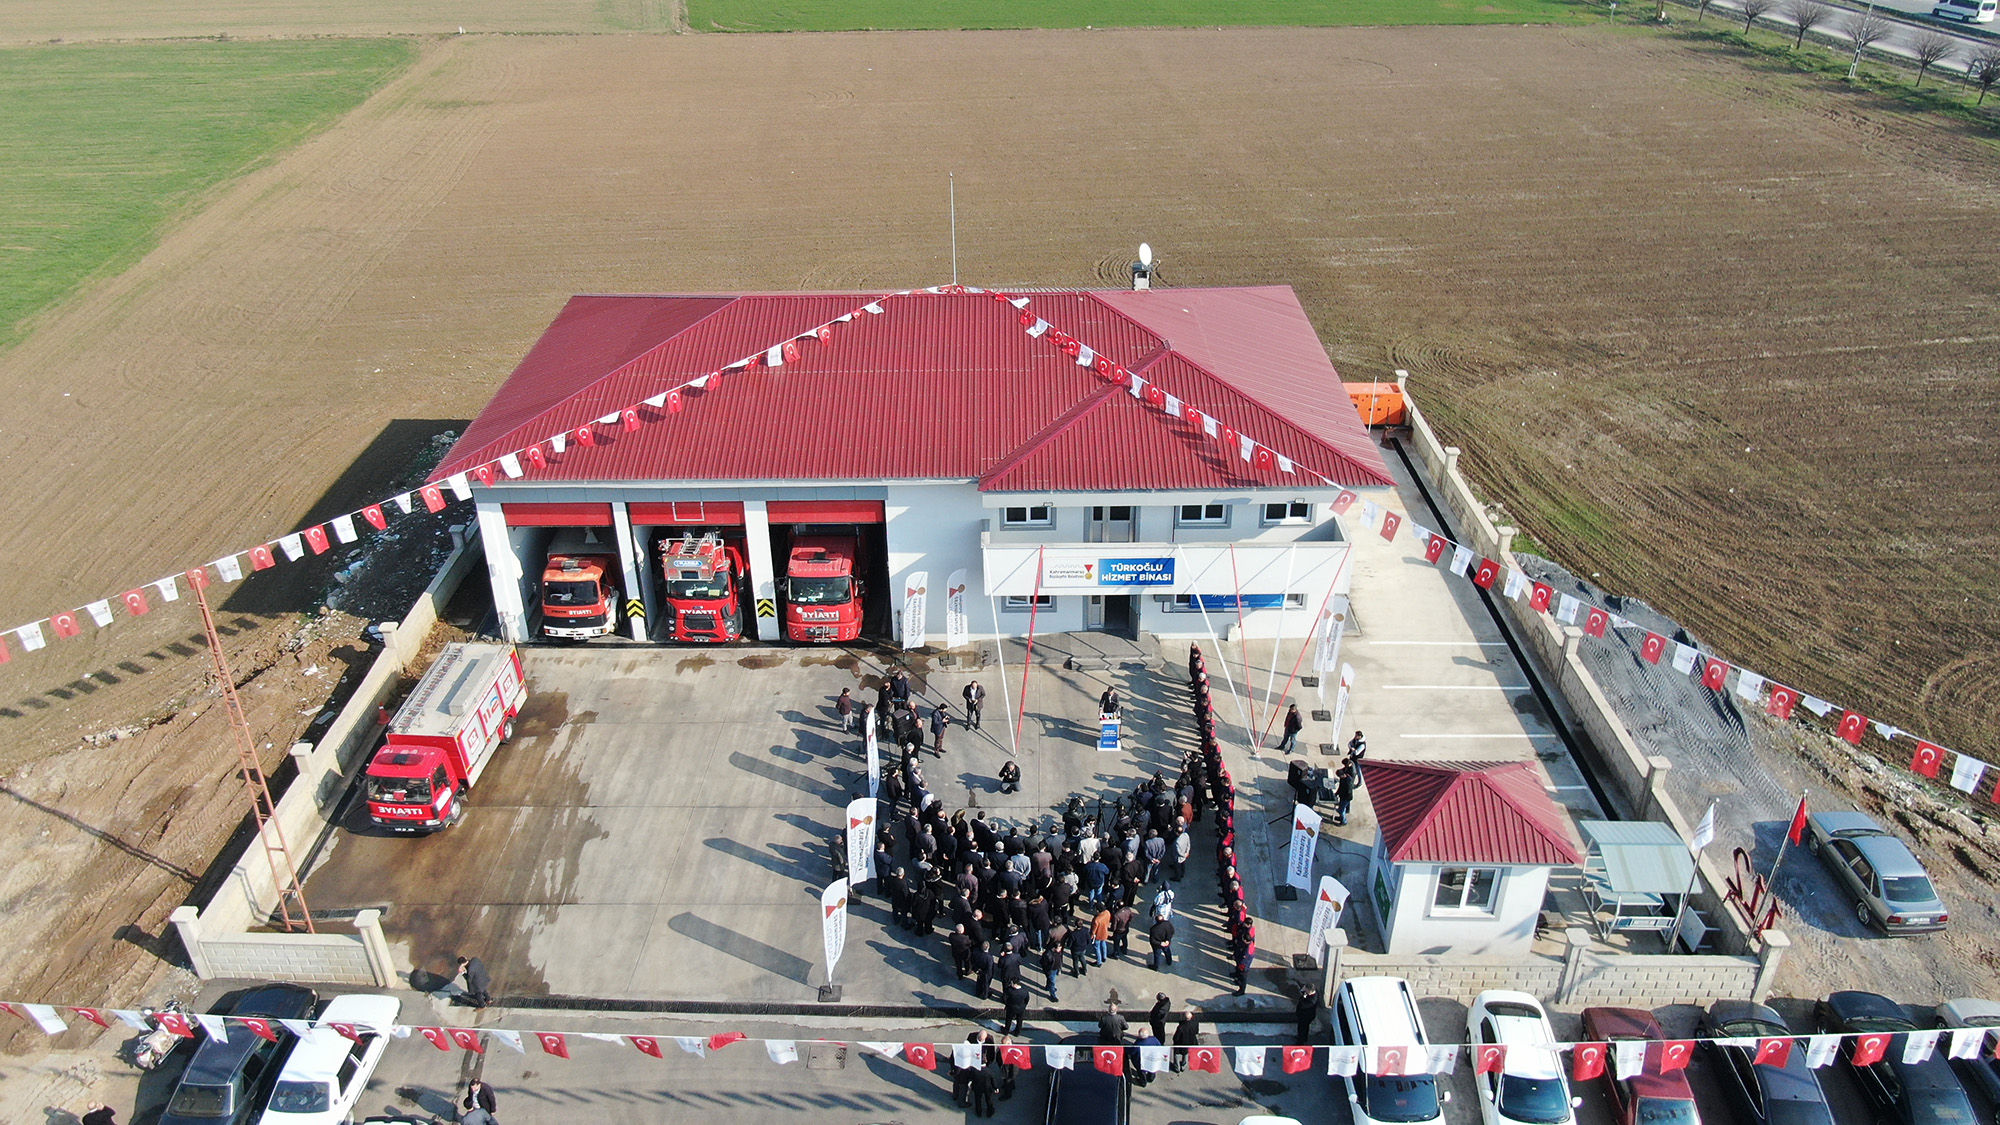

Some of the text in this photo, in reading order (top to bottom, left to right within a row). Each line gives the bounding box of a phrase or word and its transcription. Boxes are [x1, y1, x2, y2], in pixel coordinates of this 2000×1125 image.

[1110, 562, 1164, 572] TÜRKOĞLU
[1101, 572, 1172, 581] HİZMET BİNASI
